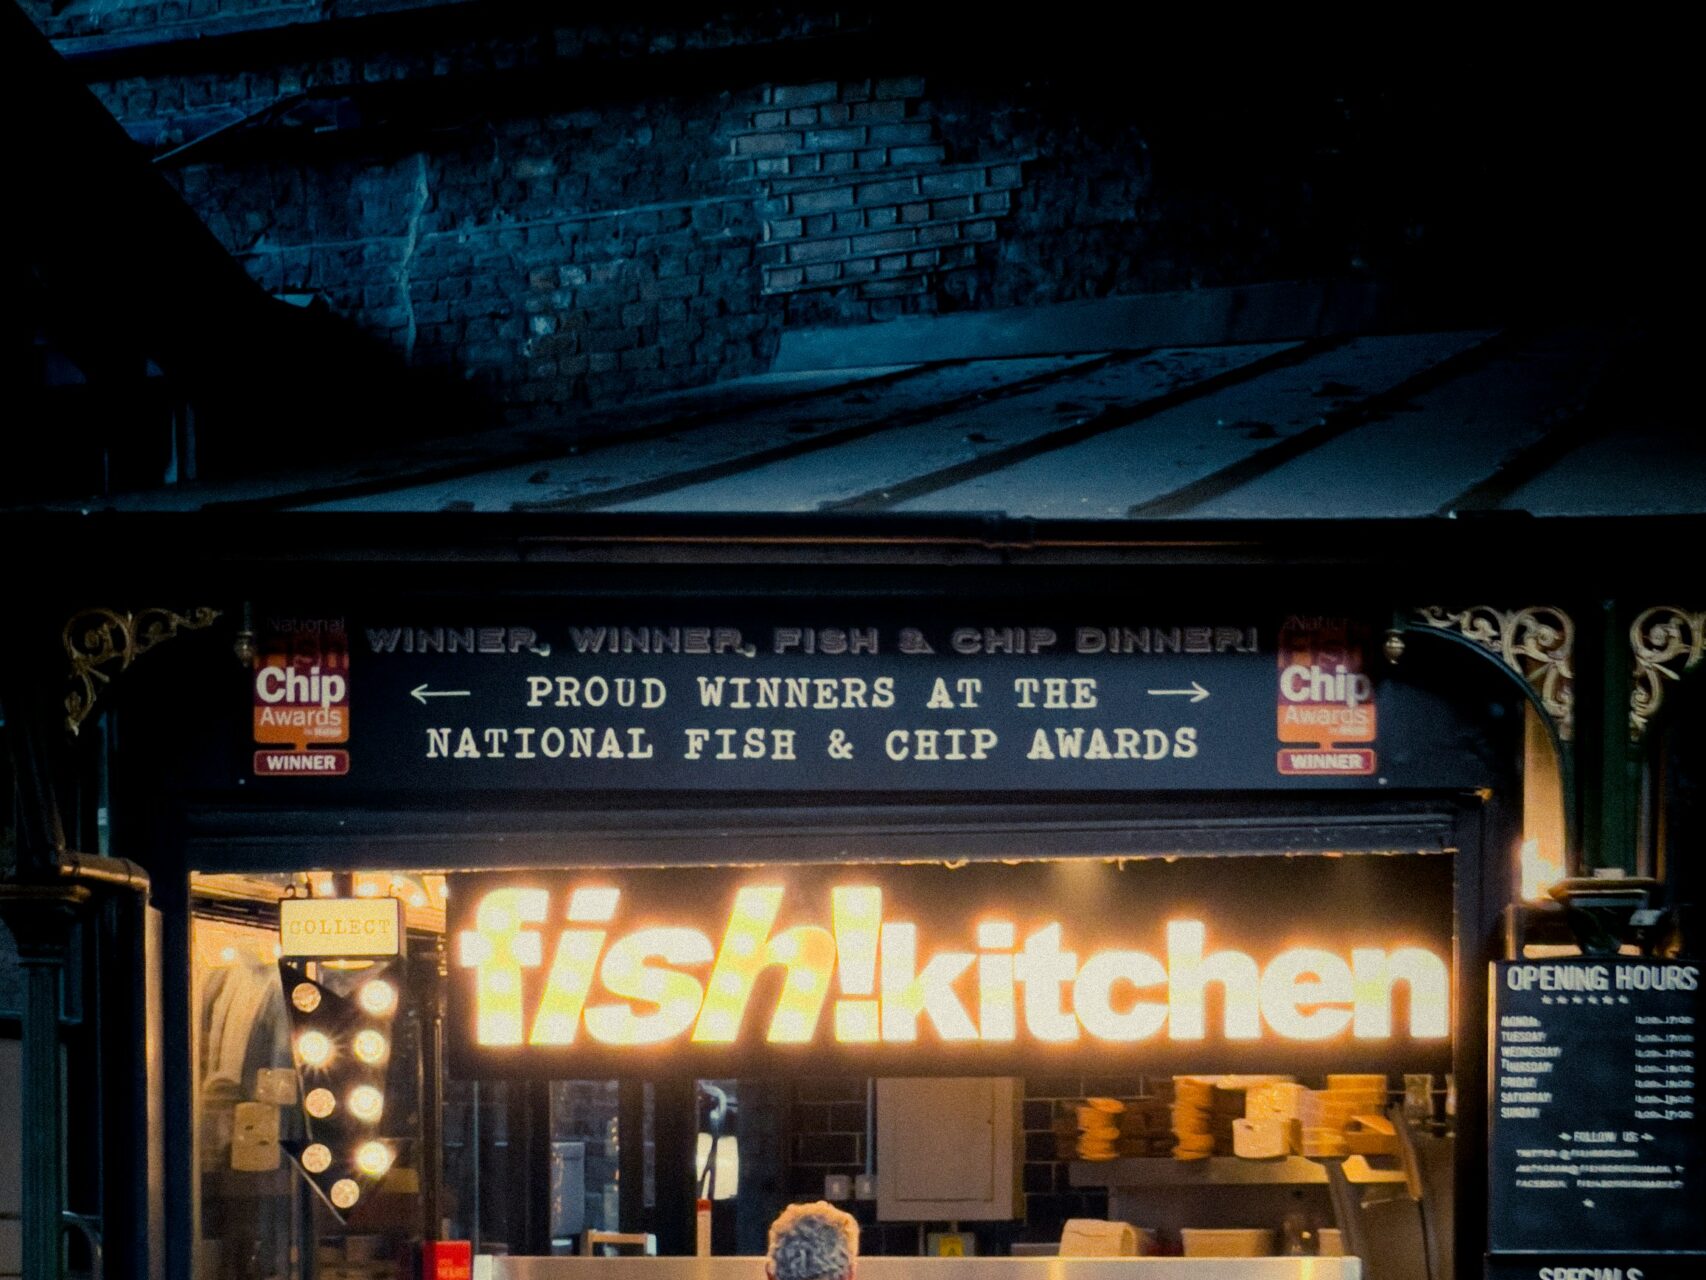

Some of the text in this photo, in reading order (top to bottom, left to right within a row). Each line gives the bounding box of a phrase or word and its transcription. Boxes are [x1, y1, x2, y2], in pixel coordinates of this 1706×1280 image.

[366, 627, 550, 657] WINNER,
[570, 627, 756, 657] WINNER,
[773, 627, 879, 655] FISH
[899, 627, 935, 655] &
[951, 627, 1058, 655] CHIP
[1076, 627, 1260, 655] DINNER!
[256, 666, 346, 709] Chip
[526, 676, 1099, 709] PROUD WINNERS AT THE
[1280, 665, 1370, 709] Chip
[260, 707, 342, 726] Awards
[1285, 705, 1367, 725] Awards
[426, 727, 1199, 760] NATIONAL FISH & CHIP AWARDS
[267, 755, 337, 771] WINNER
[1290, 754, 1364, 770] WINNER
[288, 916, 391, 935] COLLECT
[1506, 965, 1699, 991] OPENING HOURS
